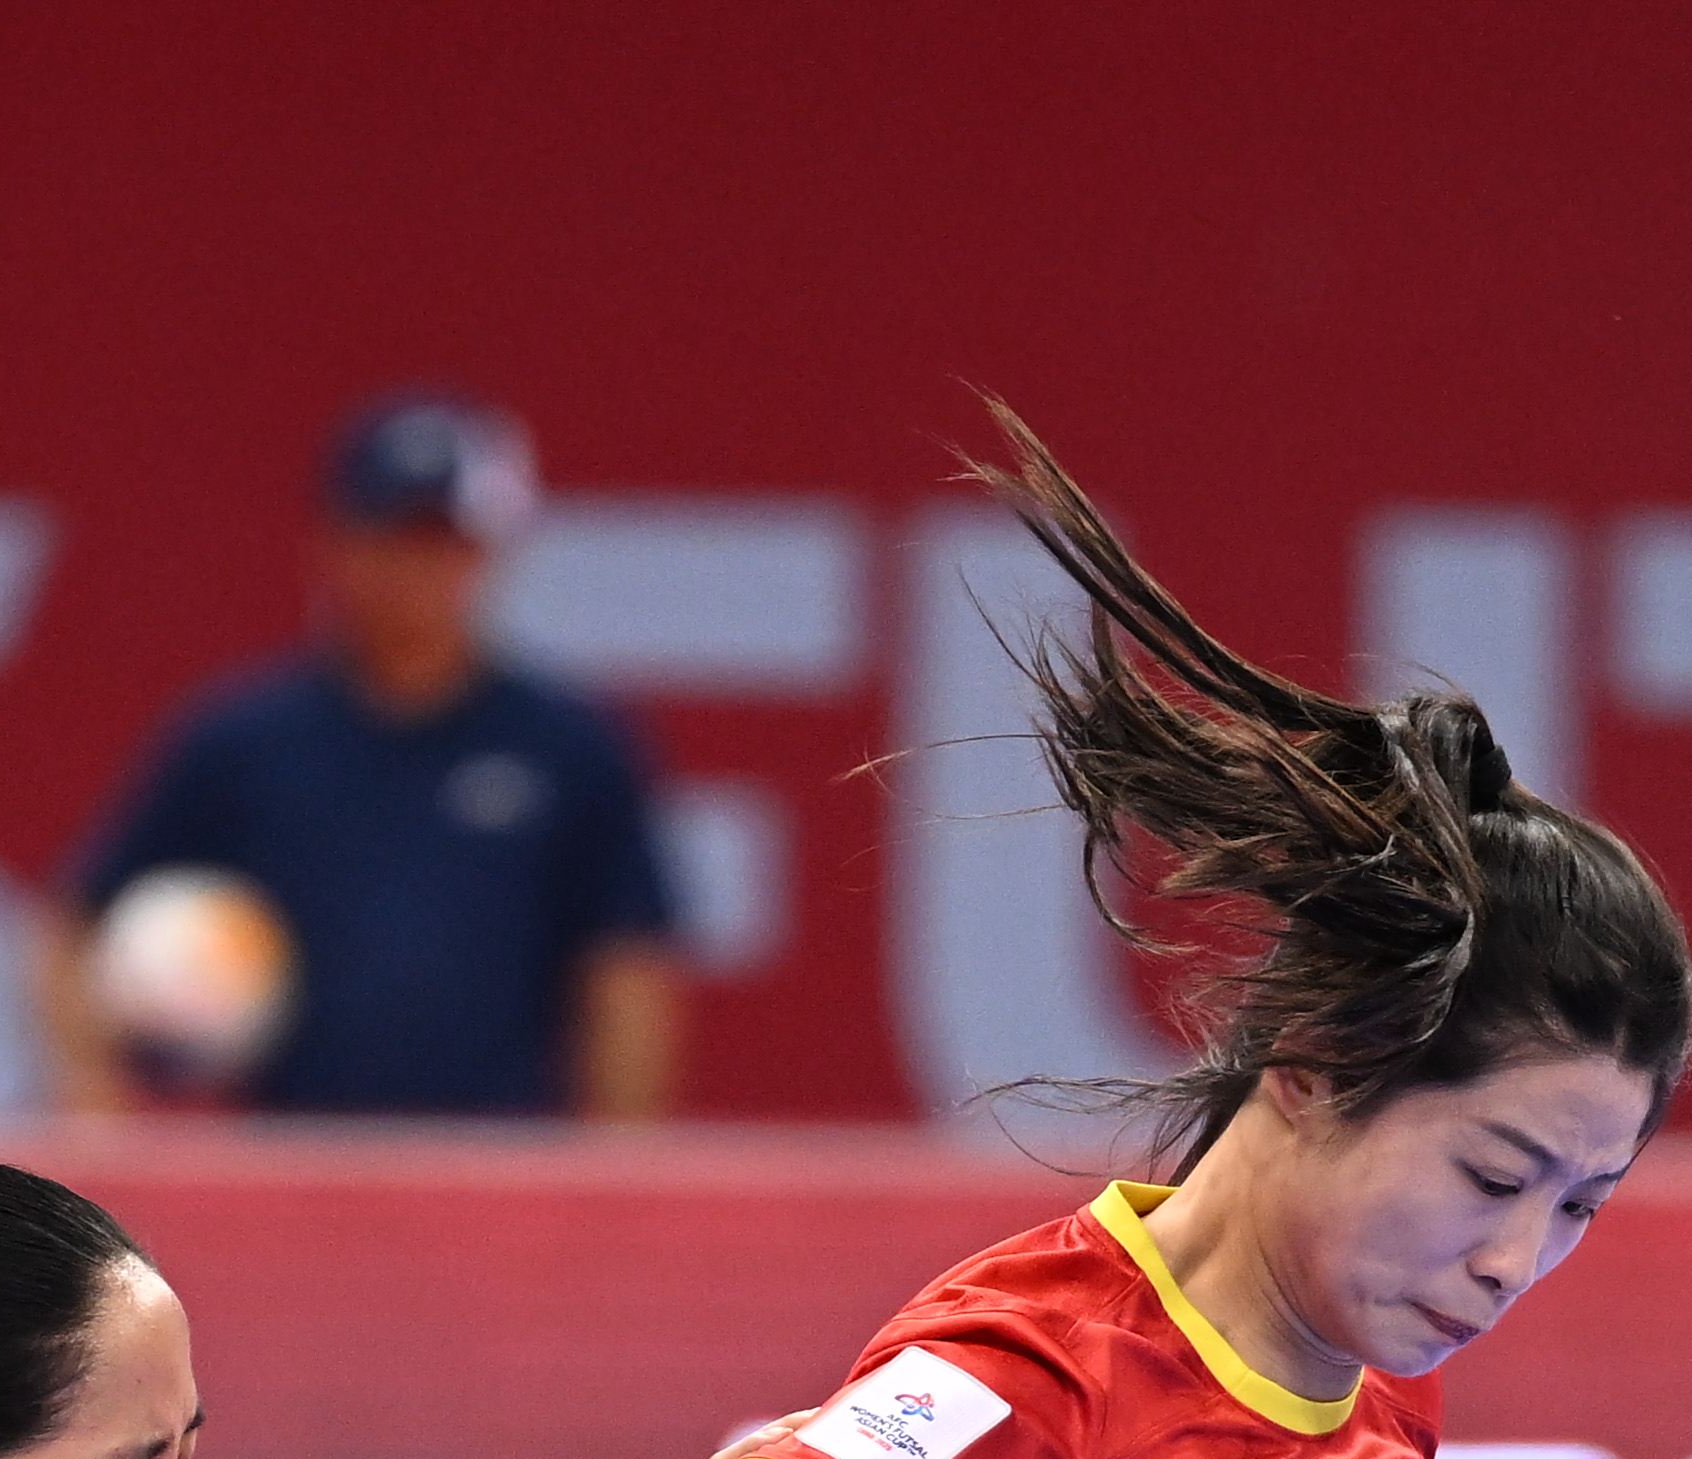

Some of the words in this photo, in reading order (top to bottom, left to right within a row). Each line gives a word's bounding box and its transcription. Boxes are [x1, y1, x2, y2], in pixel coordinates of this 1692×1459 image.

[854, 1416, 887, 1436] ASIAN
[886, 1413, 909, 1429] AFC
[850, 1405, 894, 1430] WOMEN'S
[893, 1427, 929, 1459] FUTSAL
